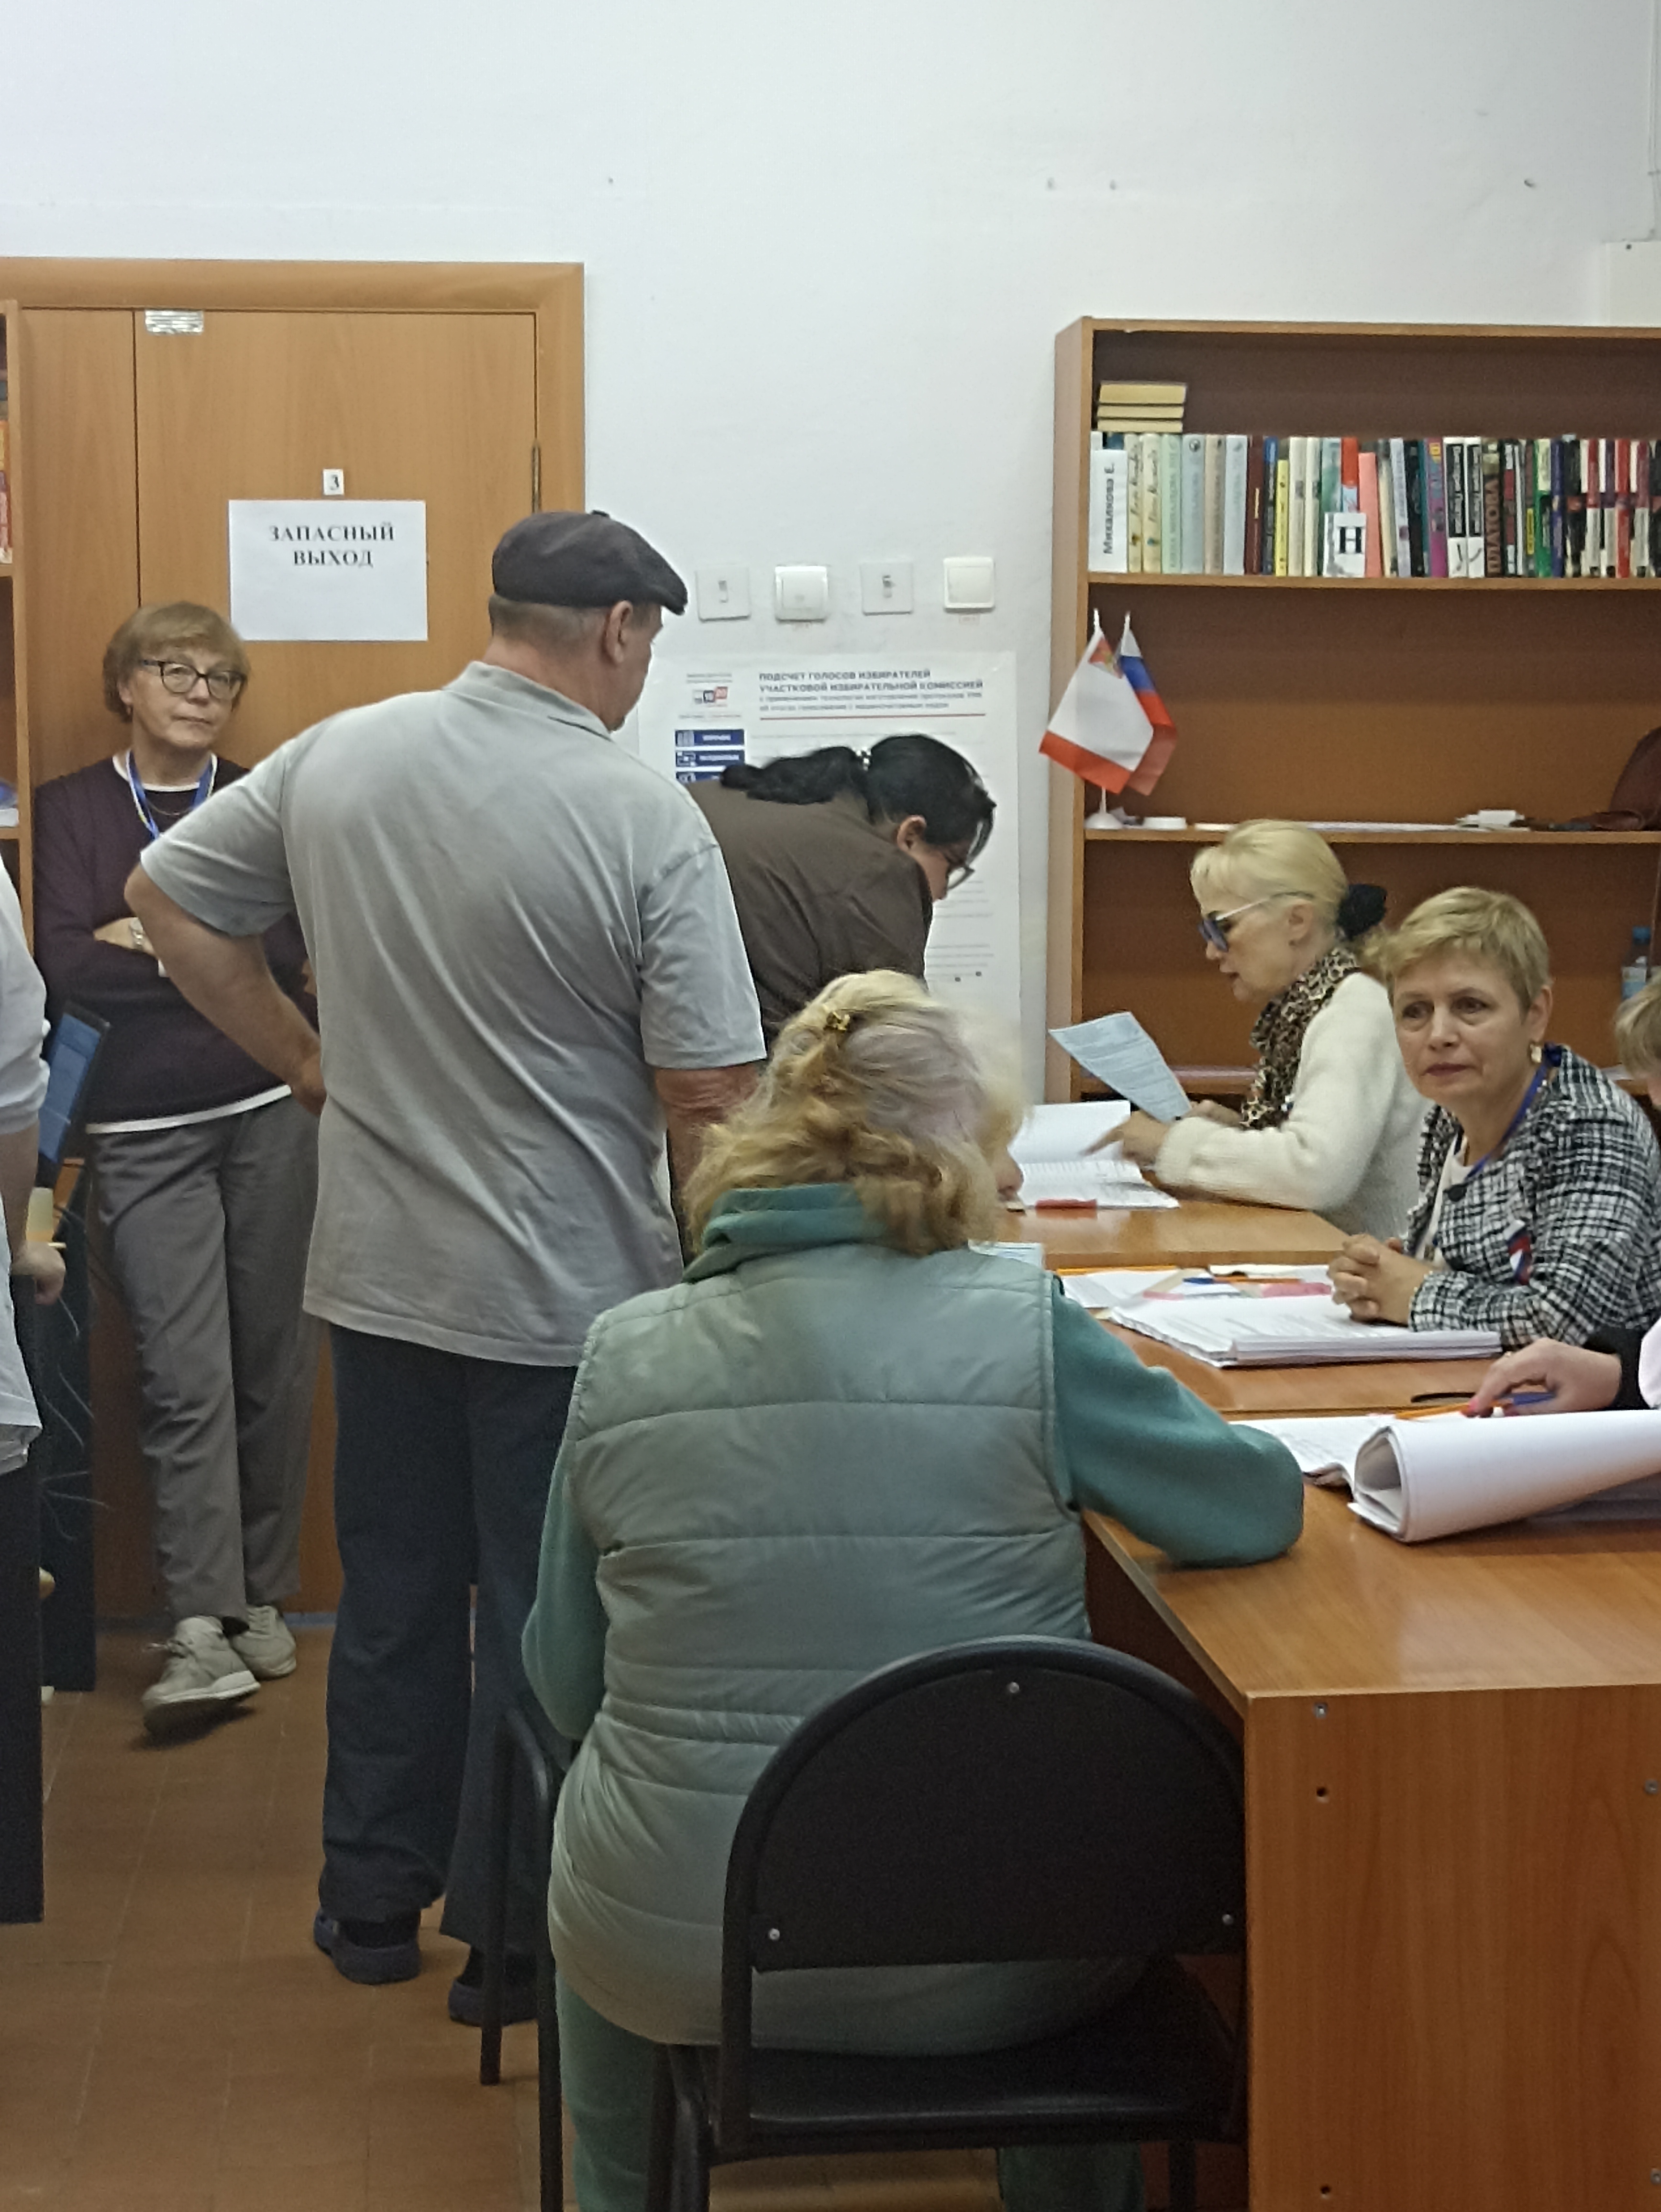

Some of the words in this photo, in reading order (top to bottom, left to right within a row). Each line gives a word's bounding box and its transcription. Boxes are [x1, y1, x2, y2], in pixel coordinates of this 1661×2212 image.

[329, 474, 340, 491] 3
[1103, 478, 1114, 555] Михалкова
[1484, 478, 1502, 574] ПЛАТОВА
[269, 521, 395, 542] ЗАПАСНЫЙ
[1339, 526, 1362, 554] Н
[293, 550, 374, 568] ВЫХОД
[809, 671, 856, 680] ГОЛОСОВ
[859, 669, 930, 679] ИЗБИРАТЕЛЕЙ
[759, 683, 827, 692] УЧАСТКОВОЙ
